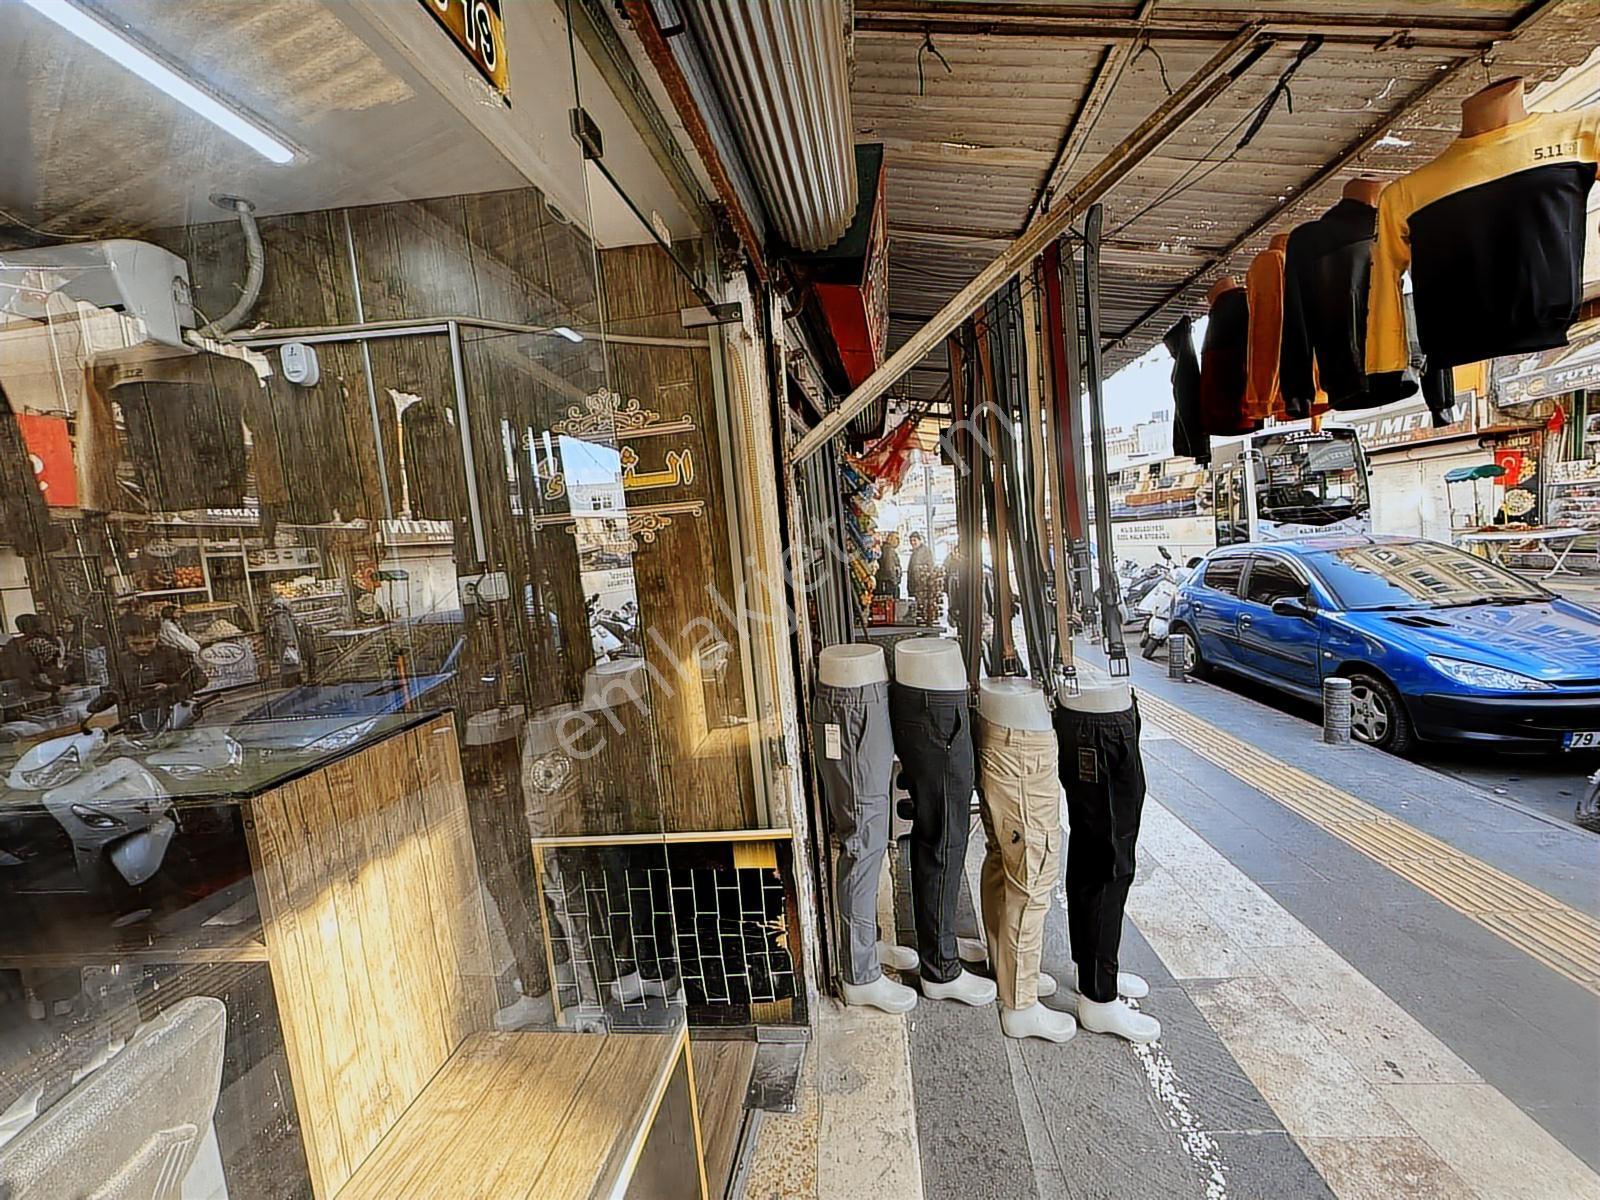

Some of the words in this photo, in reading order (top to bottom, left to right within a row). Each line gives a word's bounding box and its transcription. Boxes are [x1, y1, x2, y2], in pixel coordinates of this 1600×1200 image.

[1533, 144, 1563, 161] 5.11
[1380, 401, 1468, 436] METN
[1572, 732, 1594, 747] 79
